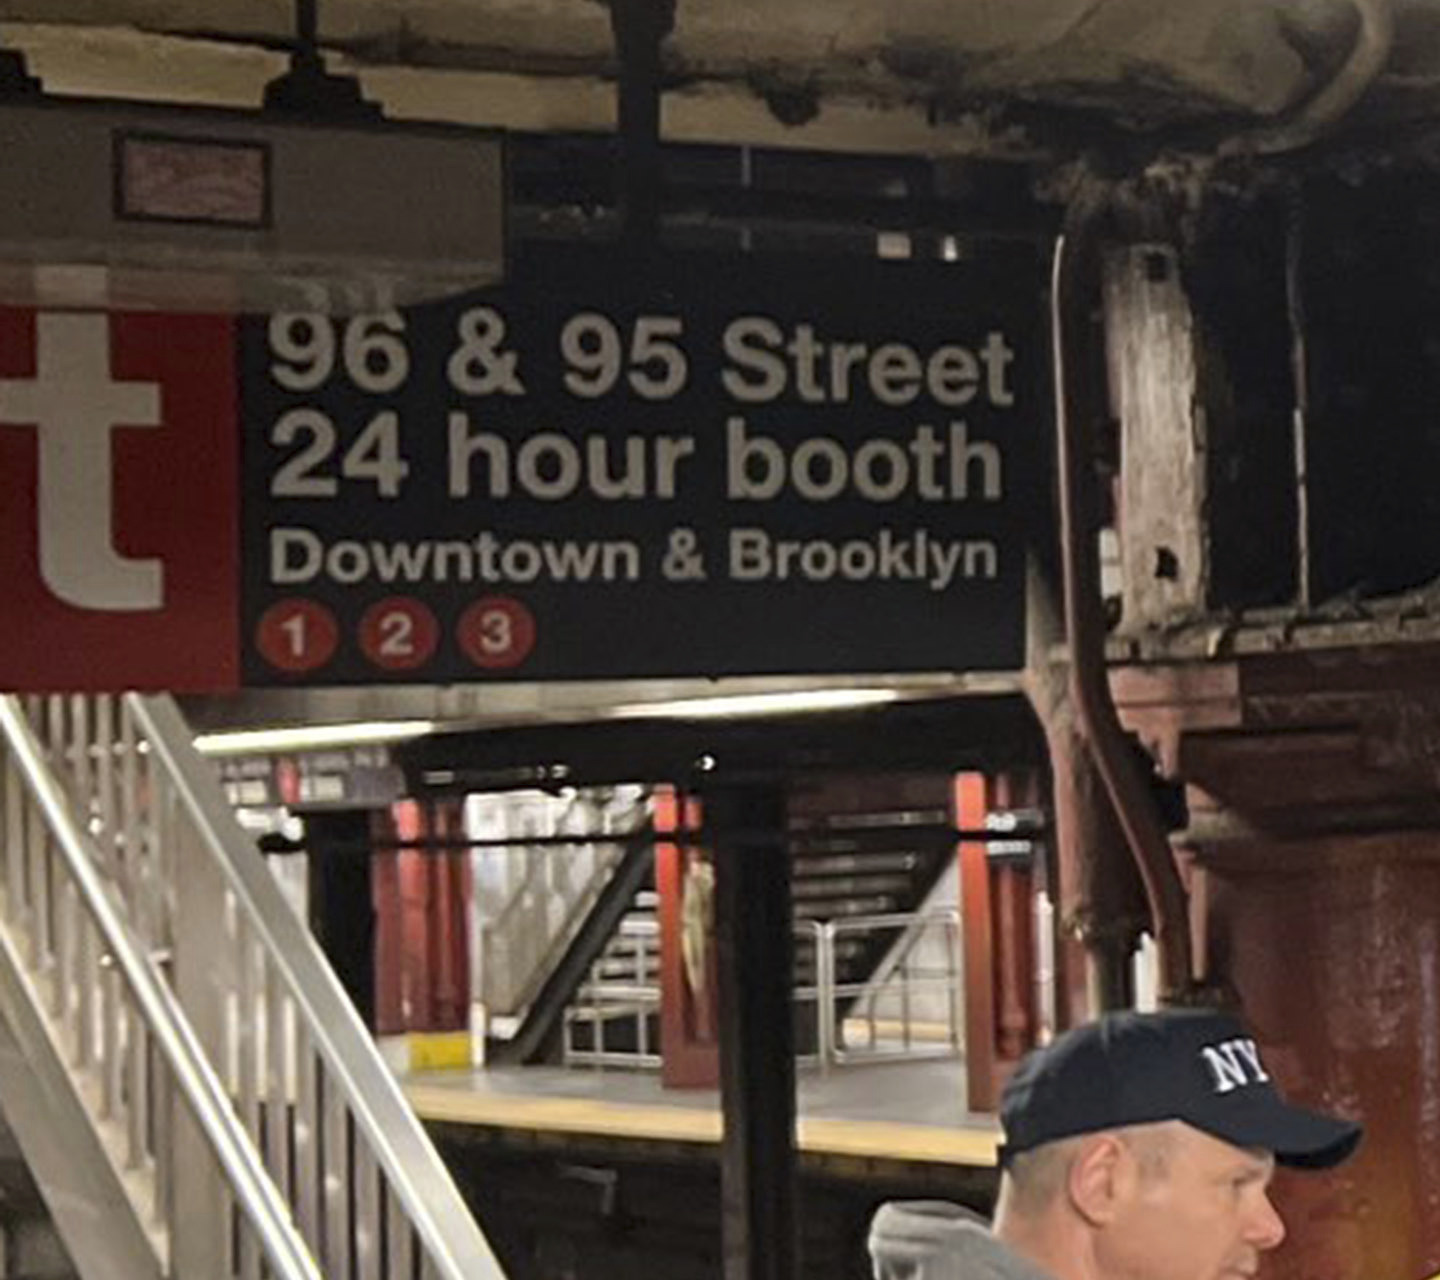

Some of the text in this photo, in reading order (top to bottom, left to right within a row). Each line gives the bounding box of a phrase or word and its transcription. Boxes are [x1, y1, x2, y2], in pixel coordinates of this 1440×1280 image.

[268, 307, 1014, 407] 96 & 95 Street
[269, 408, 1002, 500] 24 hour booth
[269, 528, 998, 590] Downtown & Brooklyn
[379, 611, 414, 655] 2
[479, 611, 512, 653] 3
